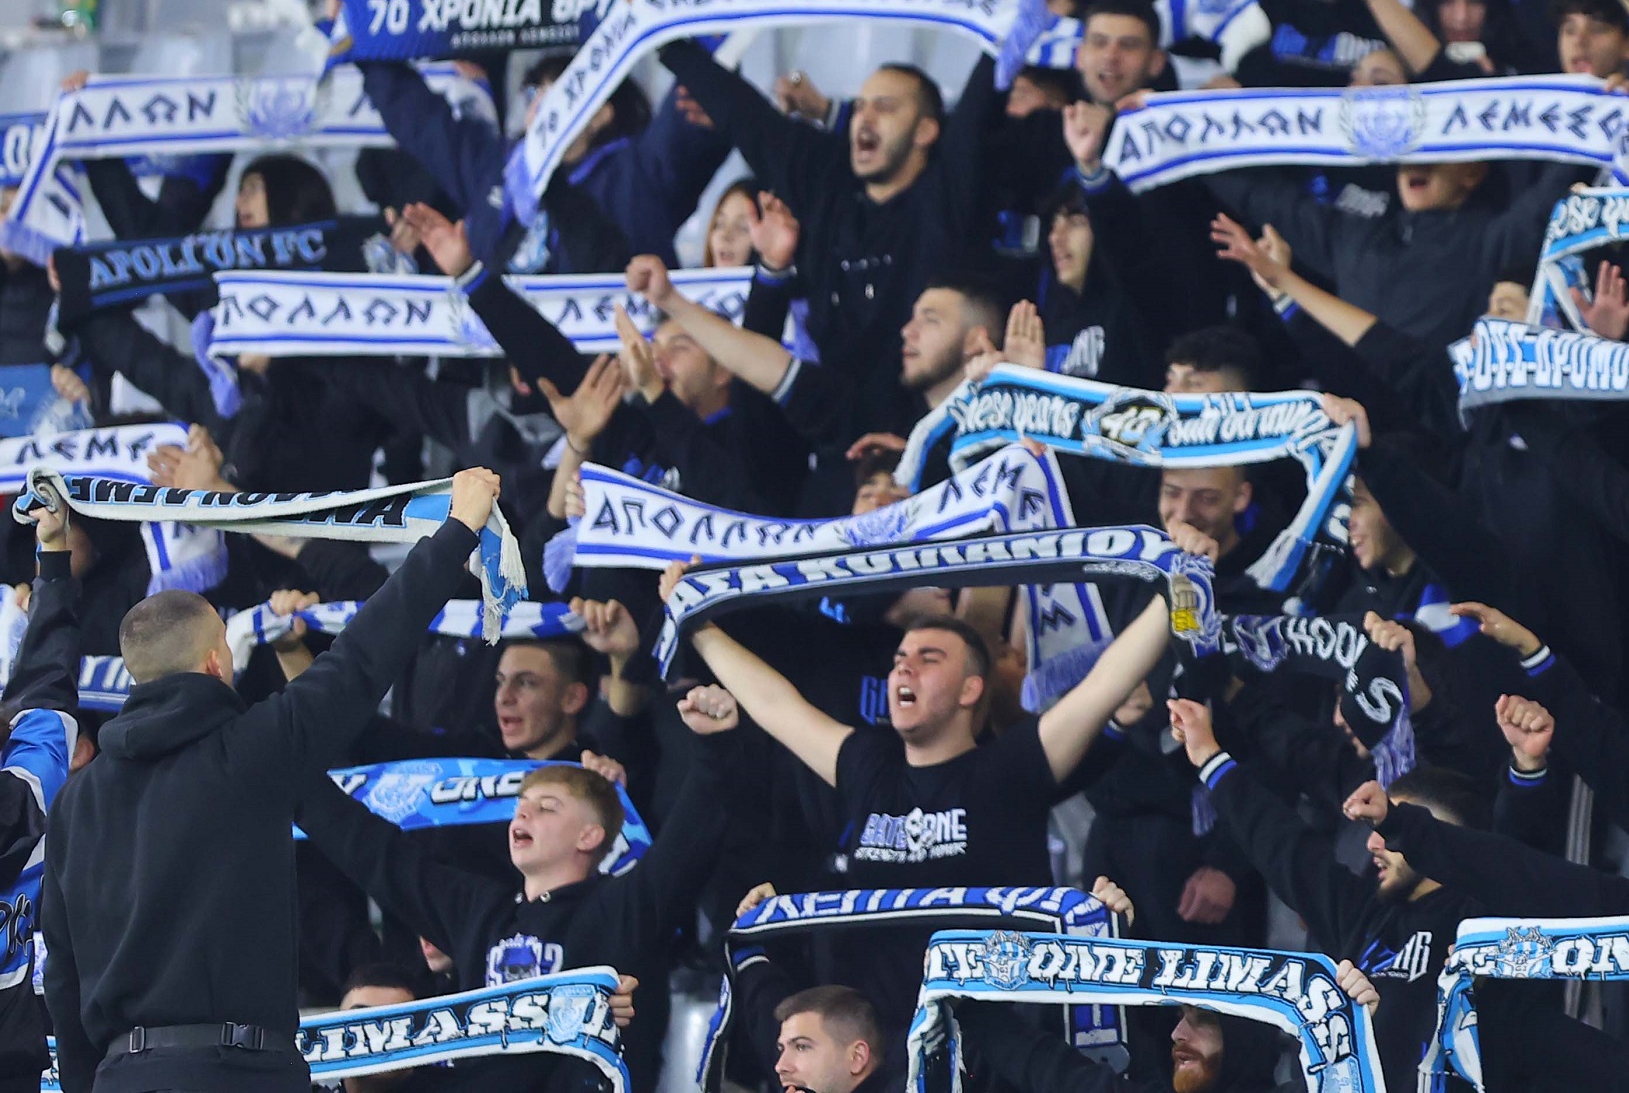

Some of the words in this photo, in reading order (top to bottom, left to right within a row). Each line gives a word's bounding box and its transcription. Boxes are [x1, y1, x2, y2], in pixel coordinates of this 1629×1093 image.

[68, 89, 218, 132] ΛΛΩΝ
[221, 291, 432, 327] ΠΟΛΛΩΝ
[1030, 949, 1144, 995] ONE
